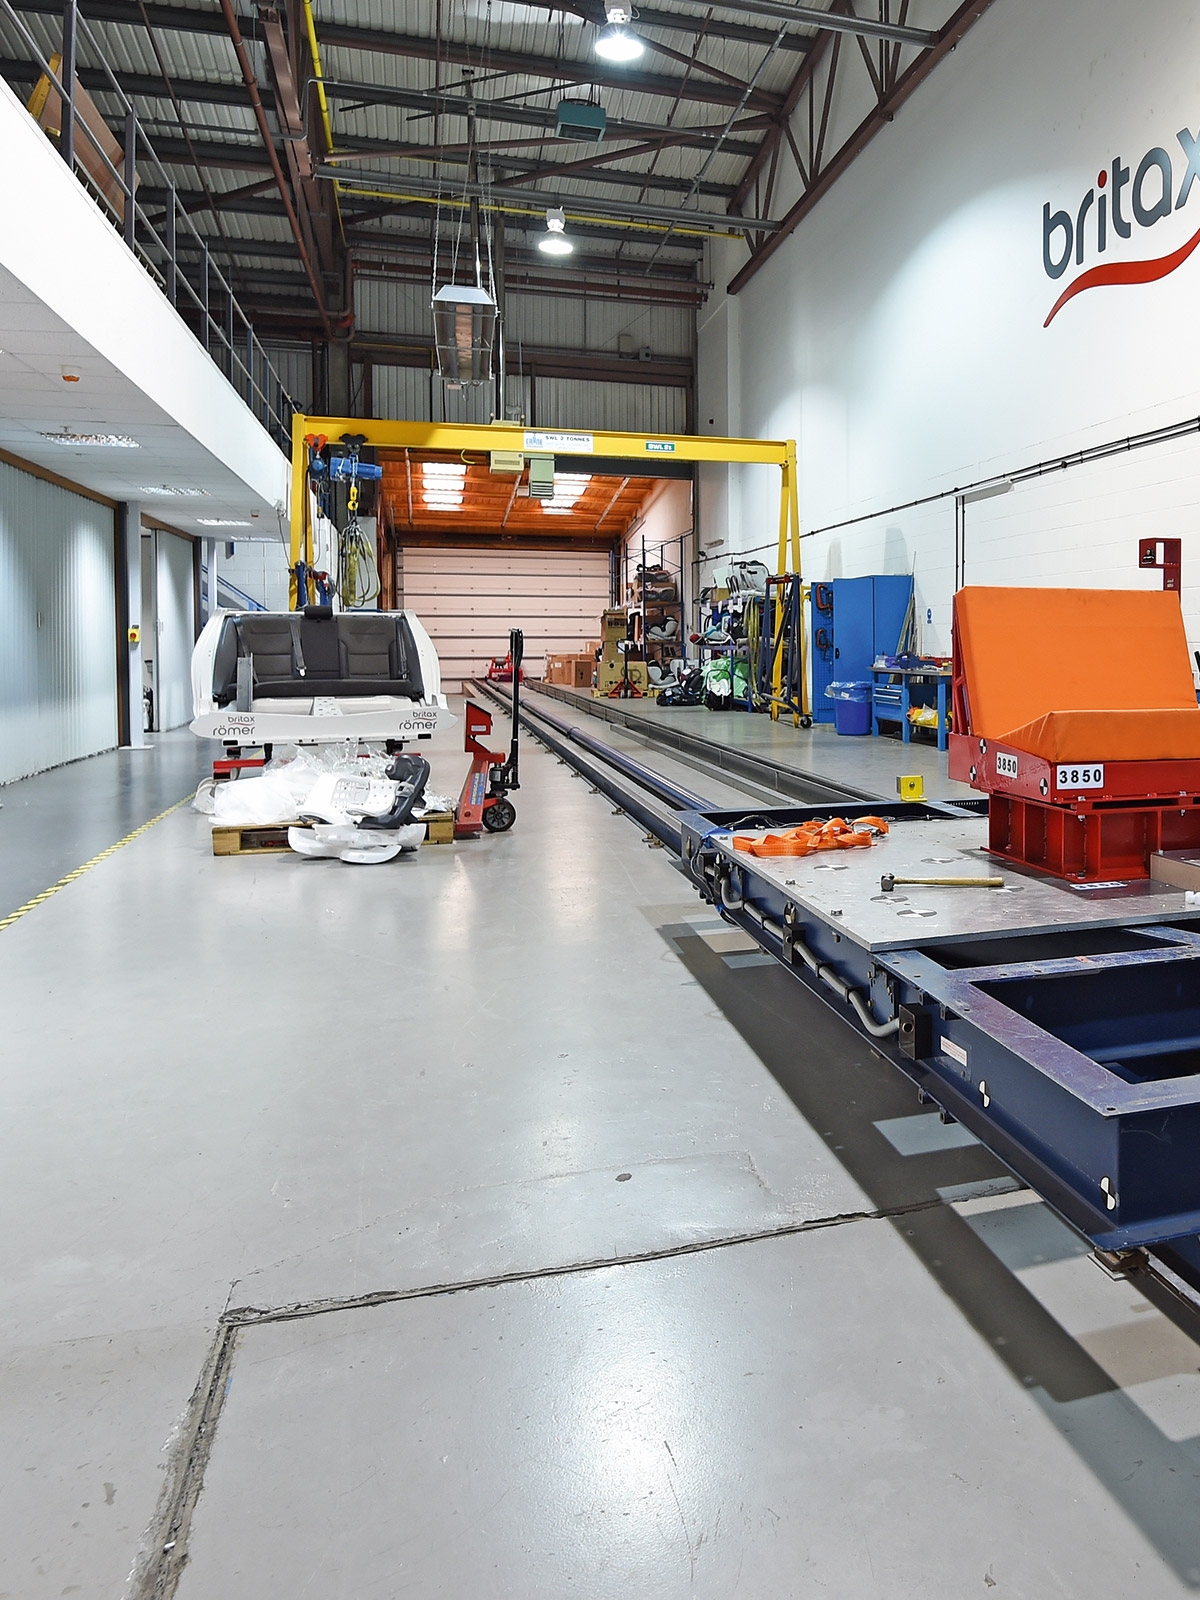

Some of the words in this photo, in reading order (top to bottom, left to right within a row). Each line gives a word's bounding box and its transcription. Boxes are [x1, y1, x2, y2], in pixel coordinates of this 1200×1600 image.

[227, 715, 256, 723] britax
[399, 720, 437, 729] römer
[212, 725, 256, 736] römer
[997, 756, 1017, 774] 3850
[1059, 769, 1102, 784] 3850
